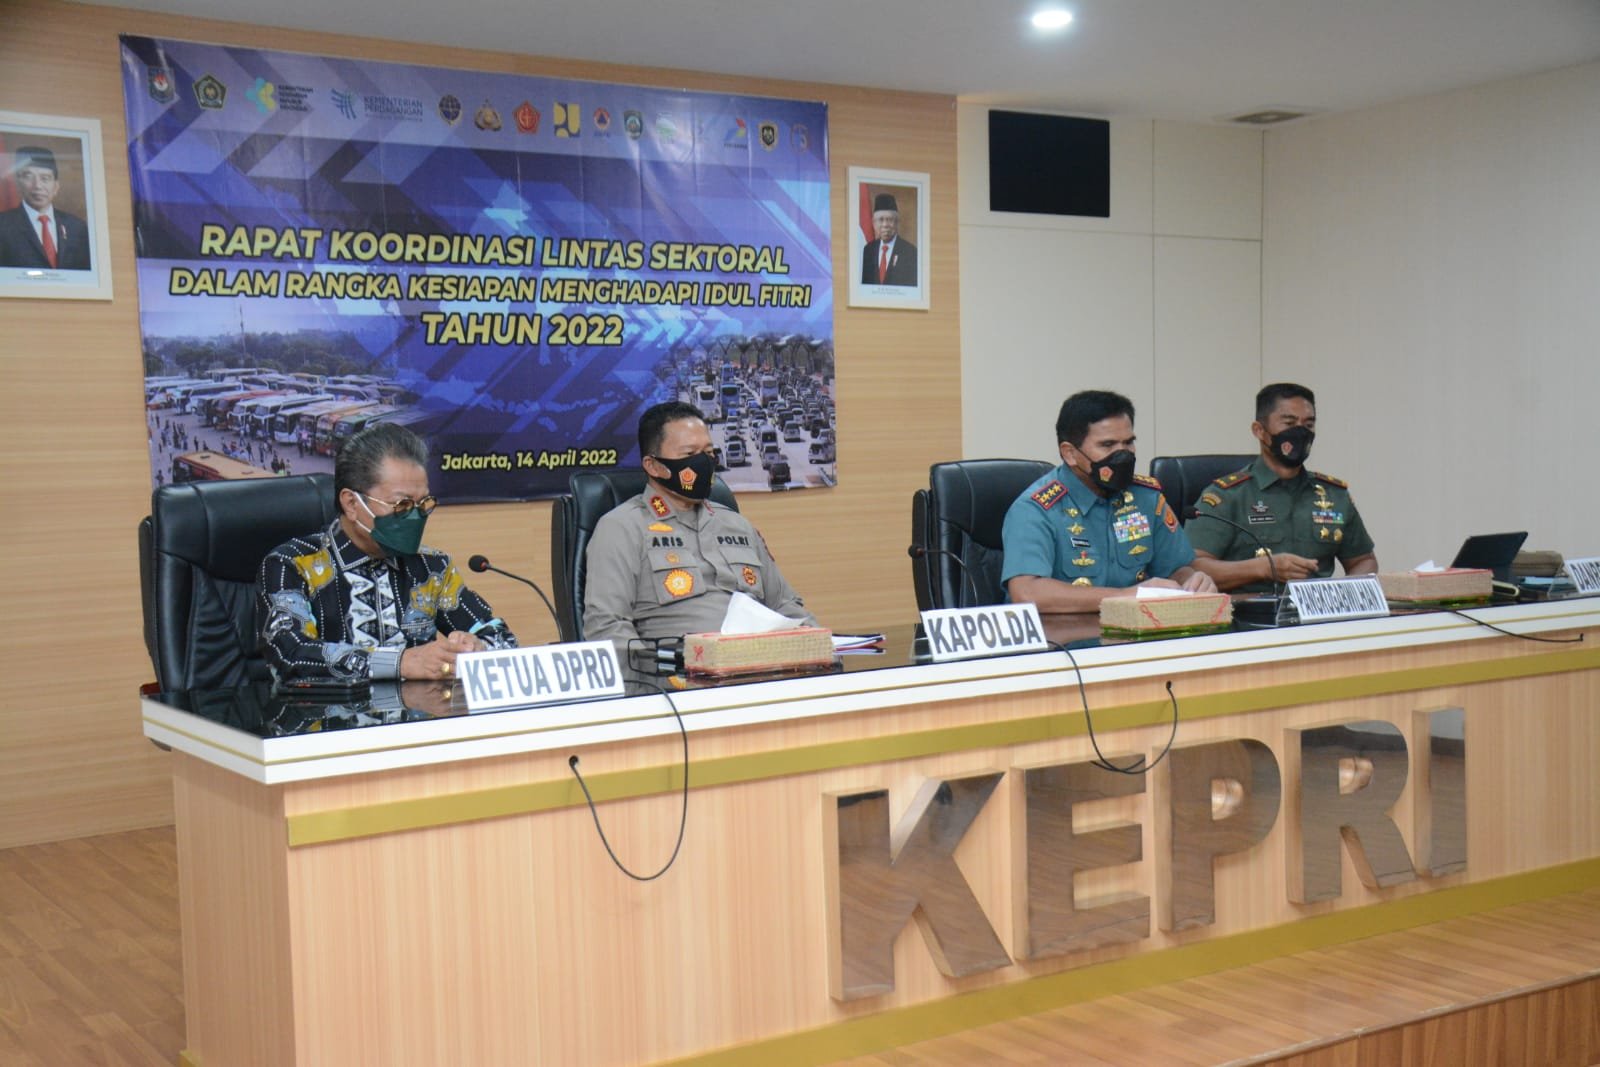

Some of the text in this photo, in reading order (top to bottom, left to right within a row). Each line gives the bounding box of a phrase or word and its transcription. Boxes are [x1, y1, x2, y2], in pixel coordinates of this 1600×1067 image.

[201, 224, 789, 274] RAPAT KOORDINASI LINTAS SEKTORAL
[170, 267, 812, 308] DALAM RANGKA KESIAPAN MENGHADAPI IDUL FITRI
[422, 312, 623, 346] TAHUN 2022
[441, 449, 617, 471] Jakarta, 14 April 2022
[652, 536, 684, 548] ARIS
[717, 536, 749, 547] POLRI
[928, 609, 1042, 654] KAPOLDA
[465, 648, 616, 702] KETUA DPRD
[824, 706, 1467, 1000] KEPRI
